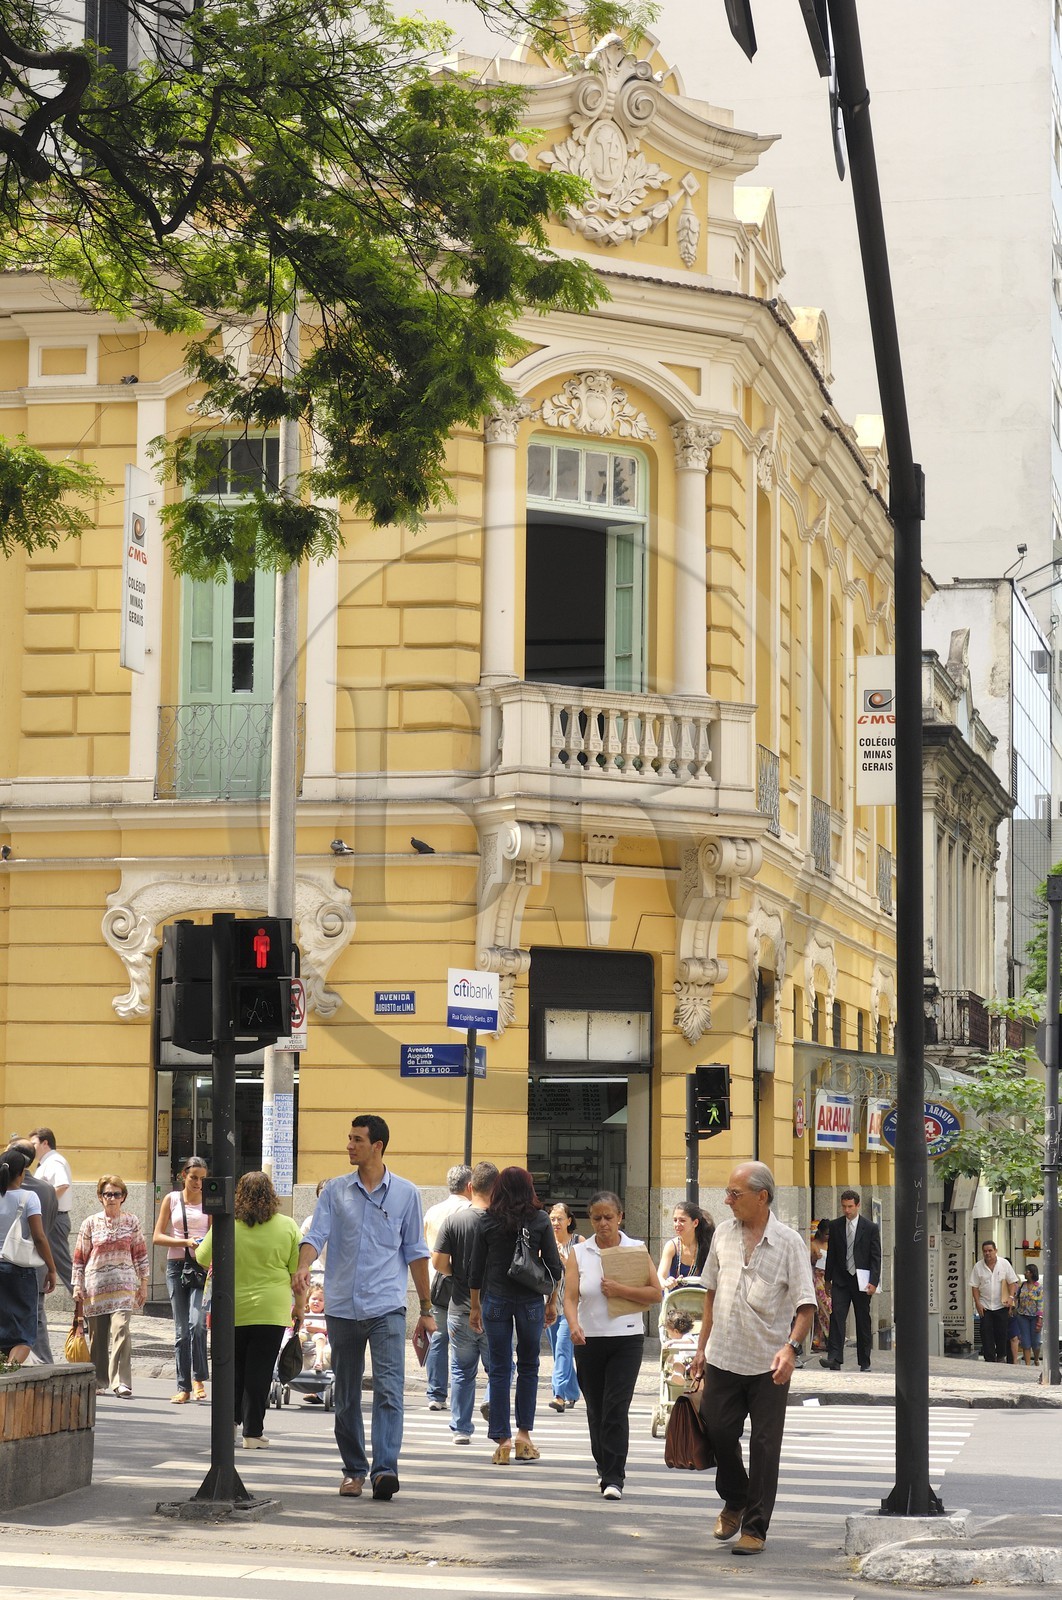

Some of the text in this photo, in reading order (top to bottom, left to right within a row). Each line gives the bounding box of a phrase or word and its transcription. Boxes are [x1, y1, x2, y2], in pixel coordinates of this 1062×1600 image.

[128, 545, 147, 565] CMG
[128, 576, 146, 594] COLÉGIO
[129, 593, 144, 610] MINAS
[128, 610, 144, 627] GERAIS
[863, 750, 892, 759] MINAS
[862, 762, 893, 771] GERAIS
[379, 993, 411, 1001] AVENIDA
[453, 980, 493, 1000] citibank
[376, 1003, 396, 1012] AUGUSTO
[401, 1003, 414, 1012] LIMA
[928, 1105, 955, 1125] ARAUJO
[925, 1121, 935, 1133] 4
[947, 1253, 959, 1311] PROMOÇÃO
